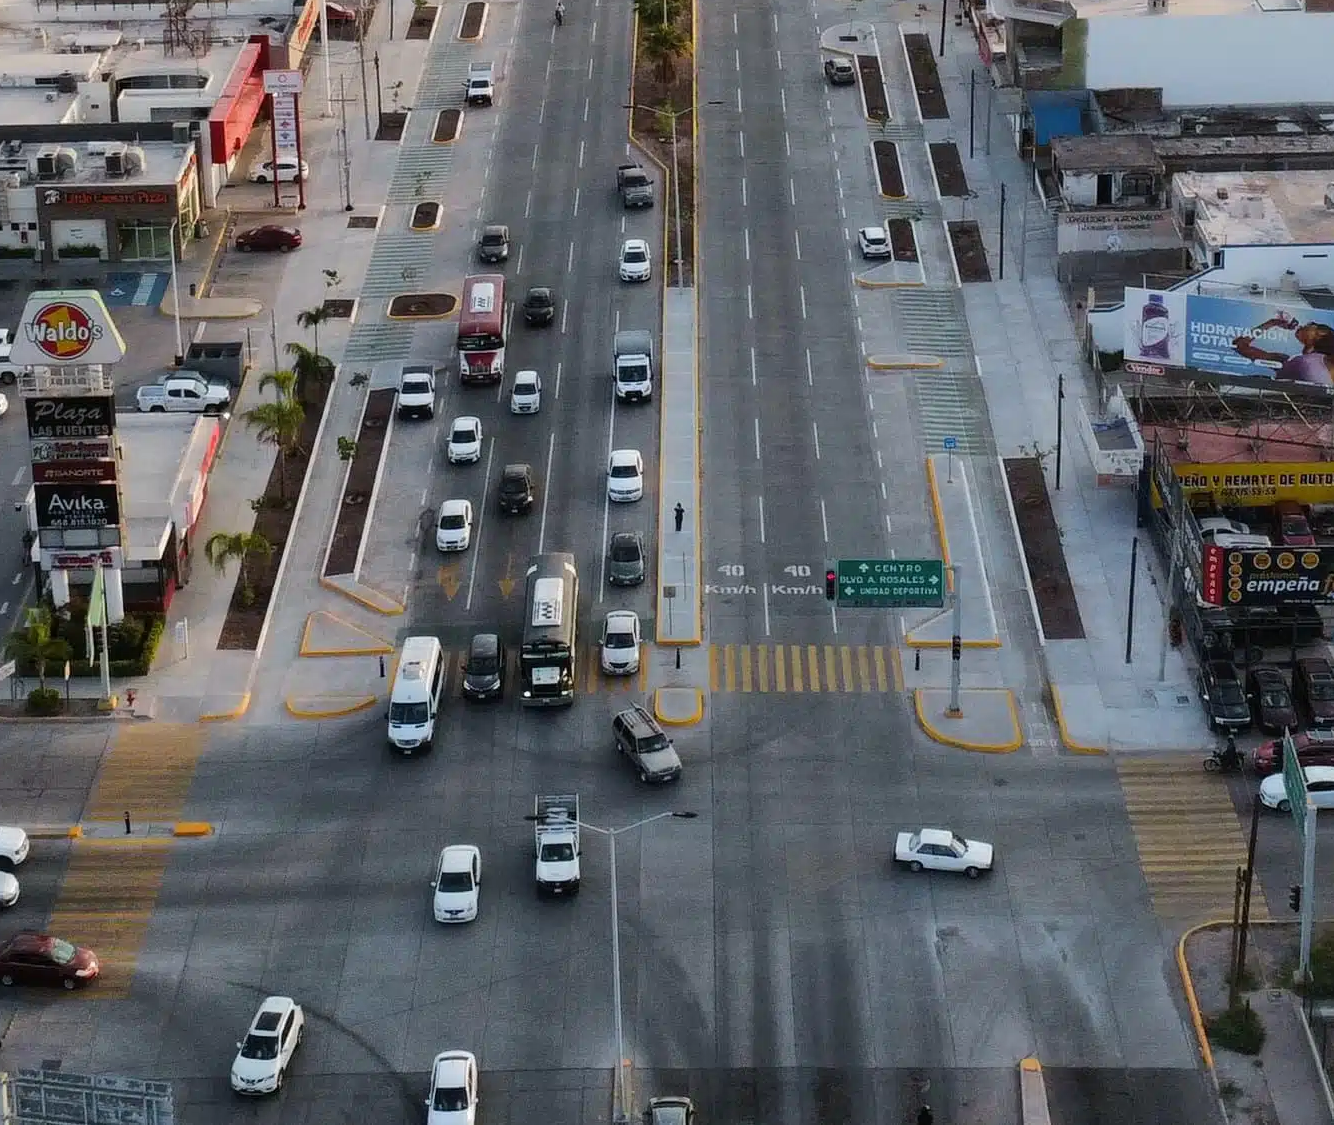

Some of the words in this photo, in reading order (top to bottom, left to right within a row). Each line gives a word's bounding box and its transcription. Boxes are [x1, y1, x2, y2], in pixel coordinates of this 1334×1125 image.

[24, 319, 103, 343] Waldo's
[1191, 333, 1237, 349] TOTAL
[34, 400, 102, 425] Plaza
[31, 425, 53, 436] LAS
[55, 424, 109, 435] FUENTES
[1212, 474, 1220, 486] Y
[1224, 474, 1276, 487] REMATE
[1279, 474, 1297, 487] DE
[48, 493, 105, 511] Avika
[717, 564, 745, 576] 40
[784, 564, 812, 576] 40
[874, 564, 922, 573] CENTRO
[879, 575, 925, 584] ROSALES
[1247, 575, 1320, 594] empeña
[705, 584, 756, 595] Km/h
[771, 584, 823, 595] Km/h
[860, 587, 889, 595] UNIDAD
[893, 587, 938, 595] DEPORTIVA
